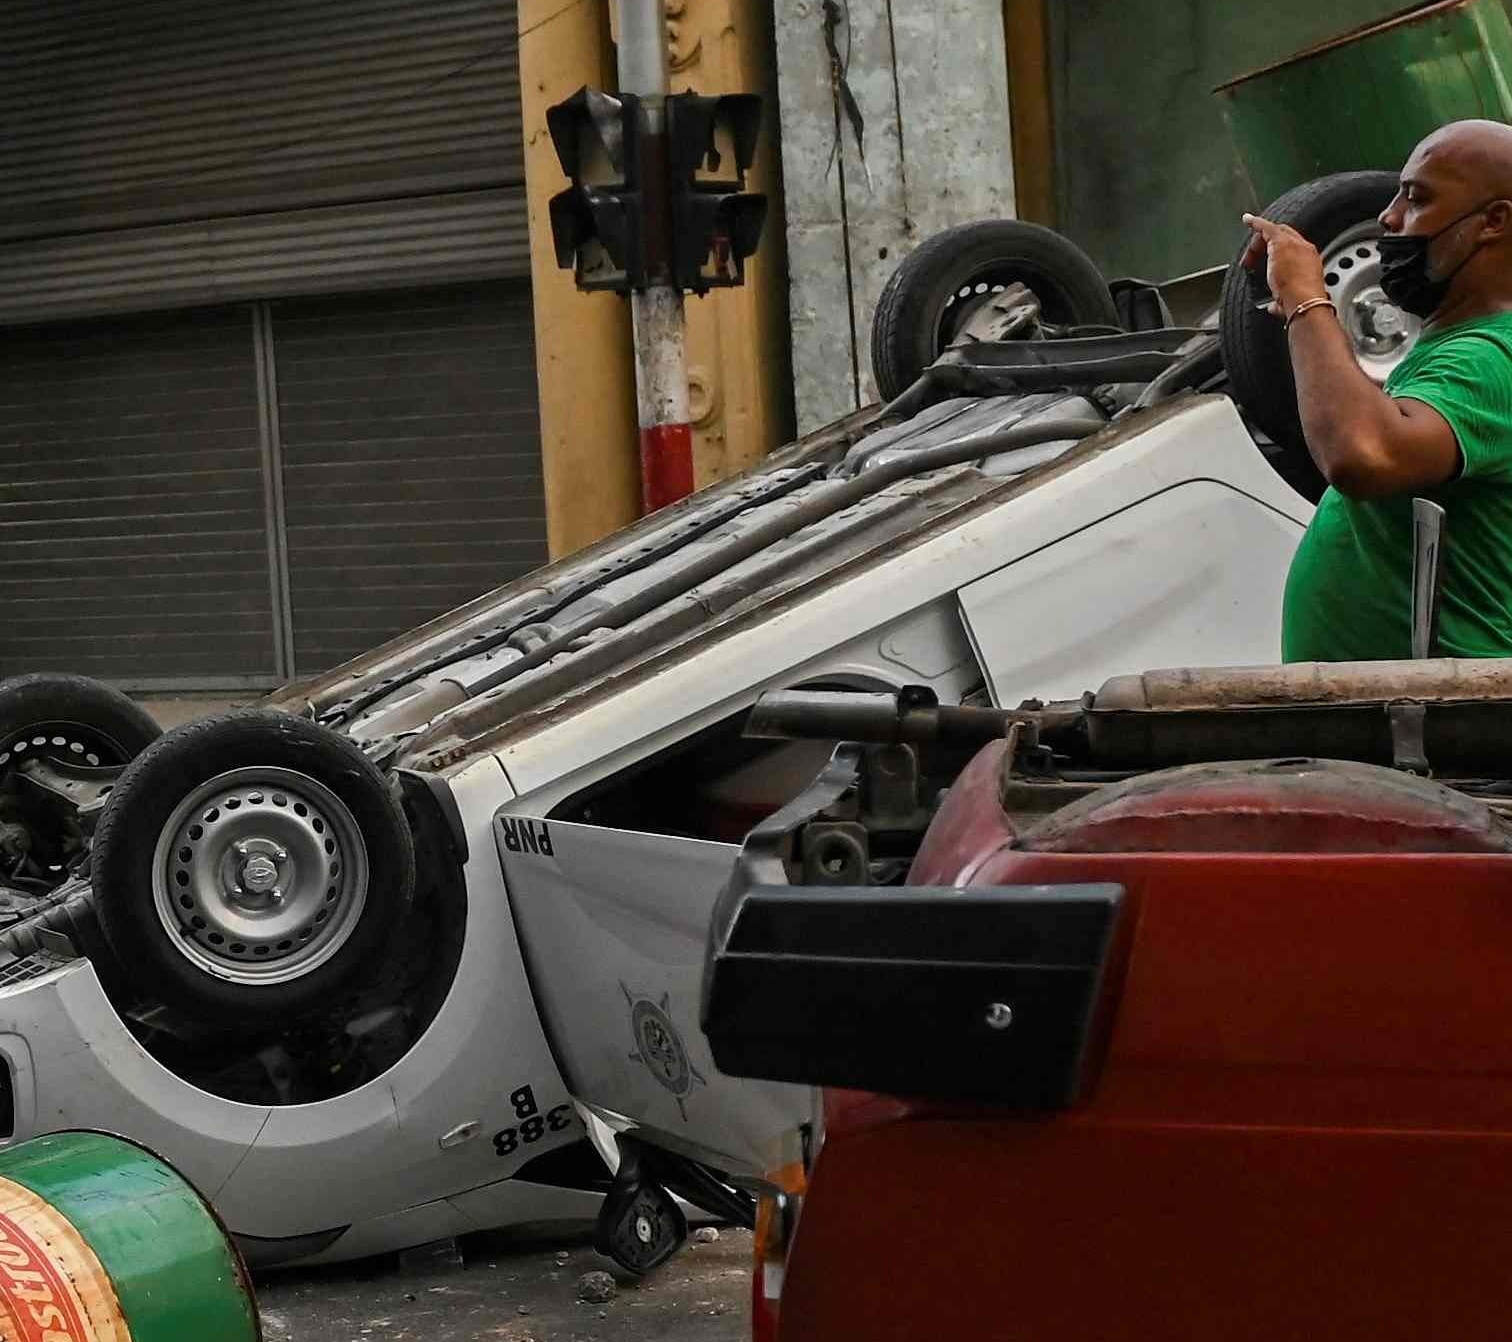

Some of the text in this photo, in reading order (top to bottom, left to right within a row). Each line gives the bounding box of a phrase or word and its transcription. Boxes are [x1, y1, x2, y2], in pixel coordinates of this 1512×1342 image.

[500, 818, 554, 857] PNR
[510, 1084, 538, 1119] B
[493, 1104, 571, 1156] 388
